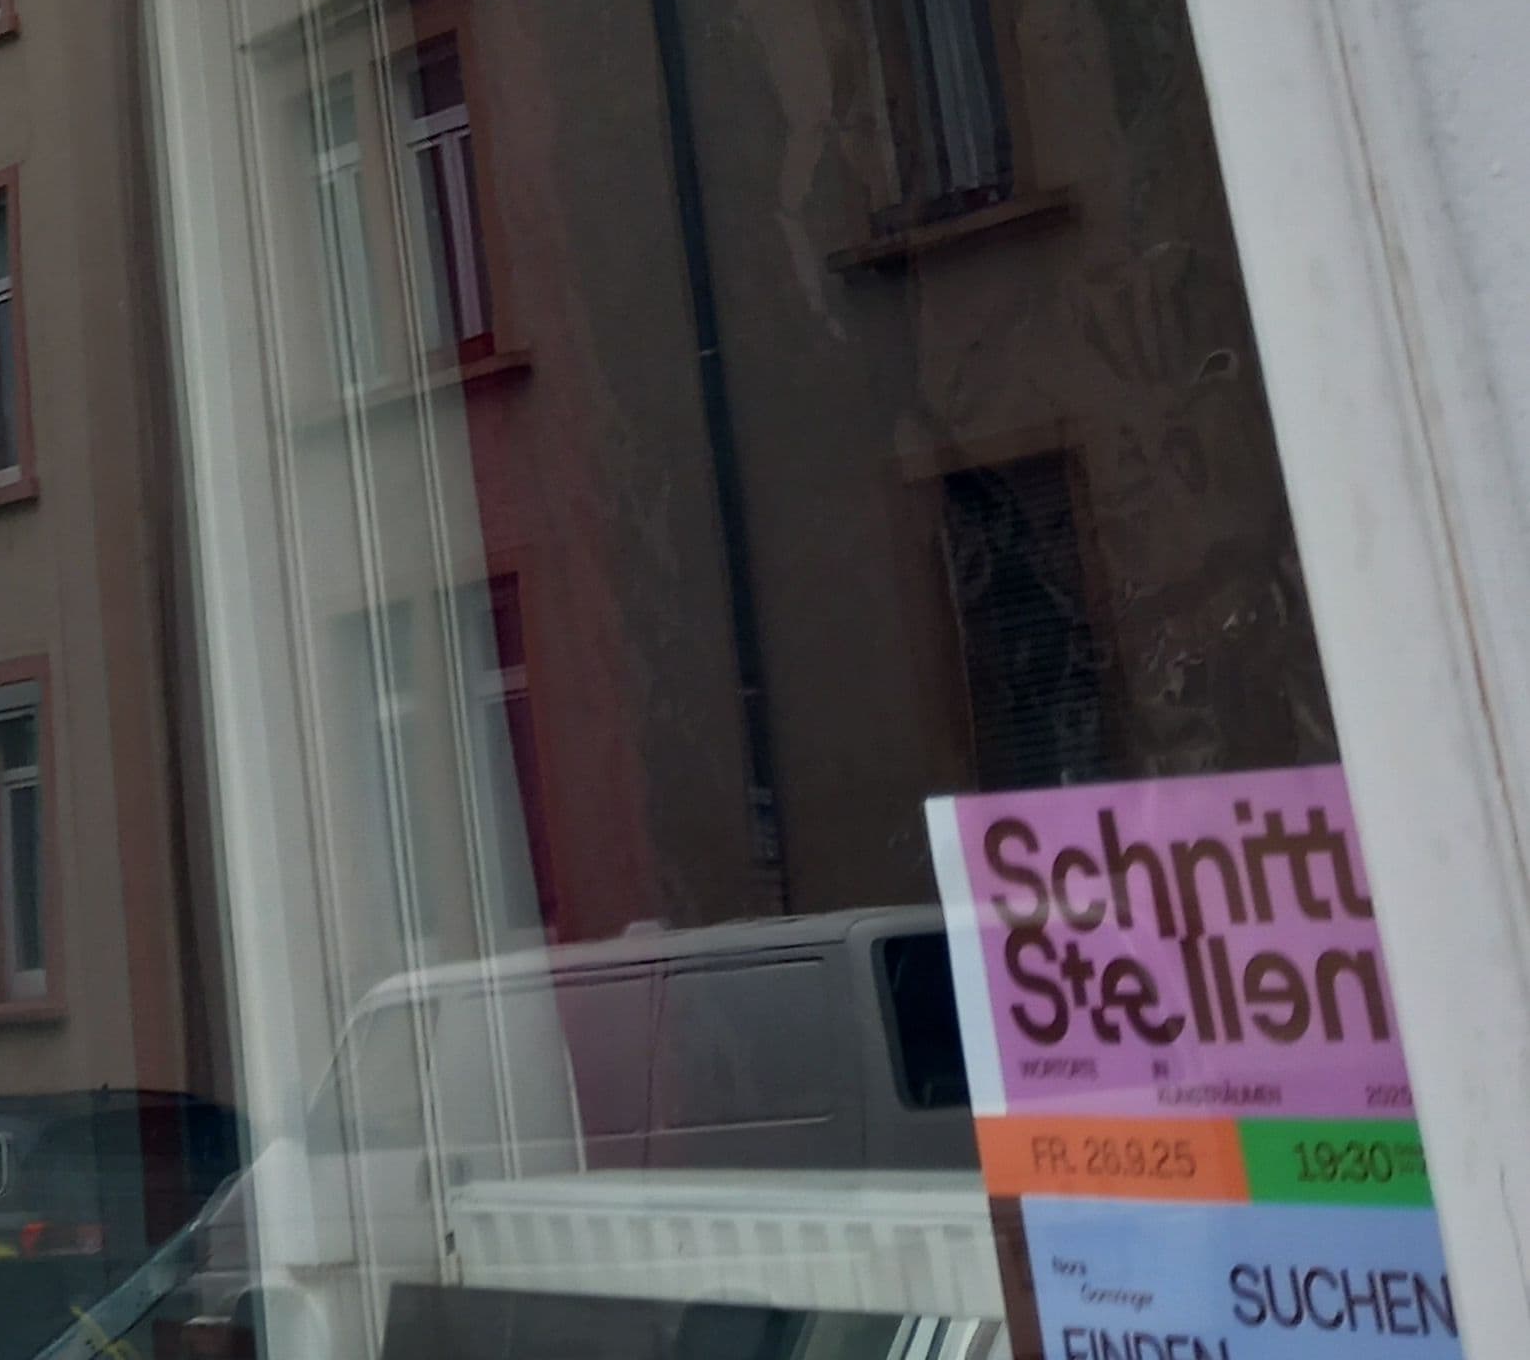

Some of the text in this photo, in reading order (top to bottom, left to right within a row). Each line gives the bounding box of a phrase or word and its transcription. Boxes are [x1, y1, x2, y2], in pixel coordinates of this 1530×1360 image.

[983, 799, 1374, 938] Schnitt
[1004, 926, 1390, 1045] Stellen
[1229, 1264, 1459, 1339] SUCHEN
